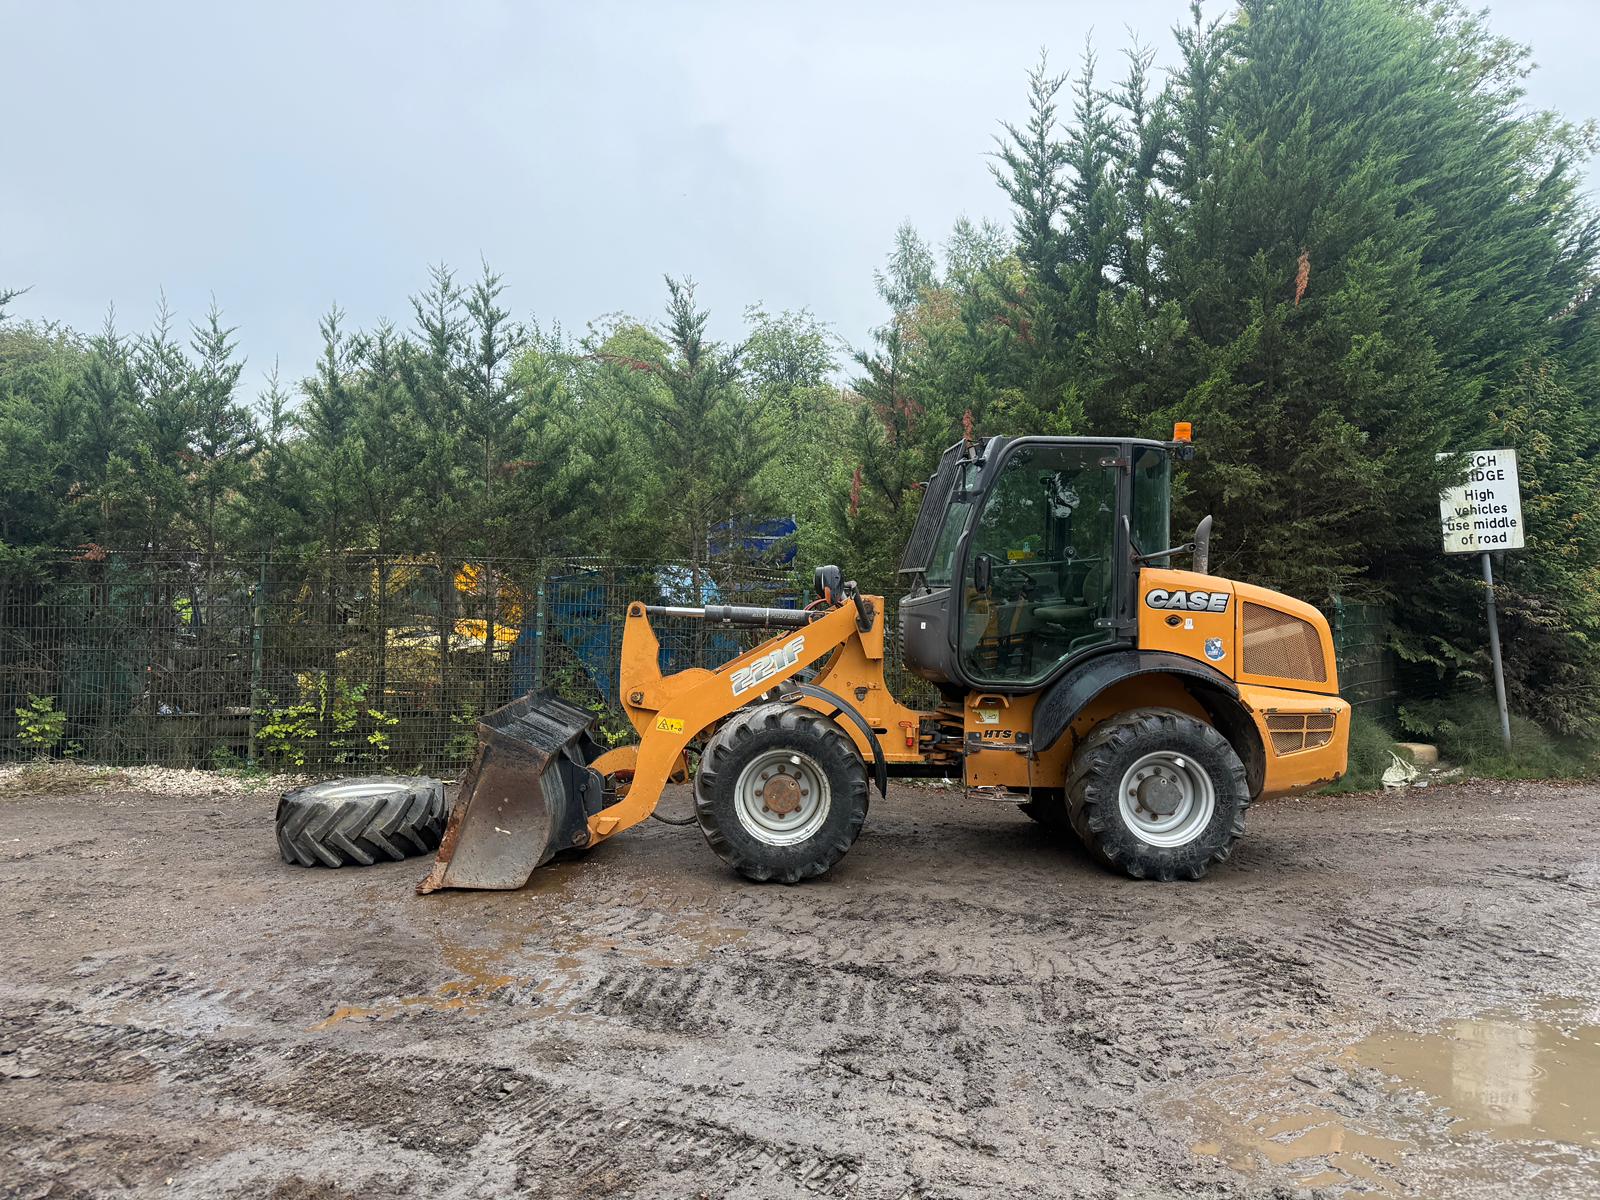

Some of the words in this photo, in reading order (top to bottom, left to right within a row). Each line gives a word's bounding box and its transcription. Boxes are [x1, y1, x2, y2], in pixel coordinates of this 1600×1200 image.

[1468, 455, 1497, 468] RCH
[1470, 469, 1505, 482] IDGE
[1464, 488, 1495, 501] High
[1454, 503, 1508, 516] vehicles
[1447, 522, 1470, 532] use
[1473, 517, 1517, 530] middle
[1461, 533, 1474, 545] of
[1477, 531, 1508, 544] road
[1145, 588, 1230, 613] CASE
[730, 635, 805, 696] 221F
[983, 729, 1012, 738] HTS
